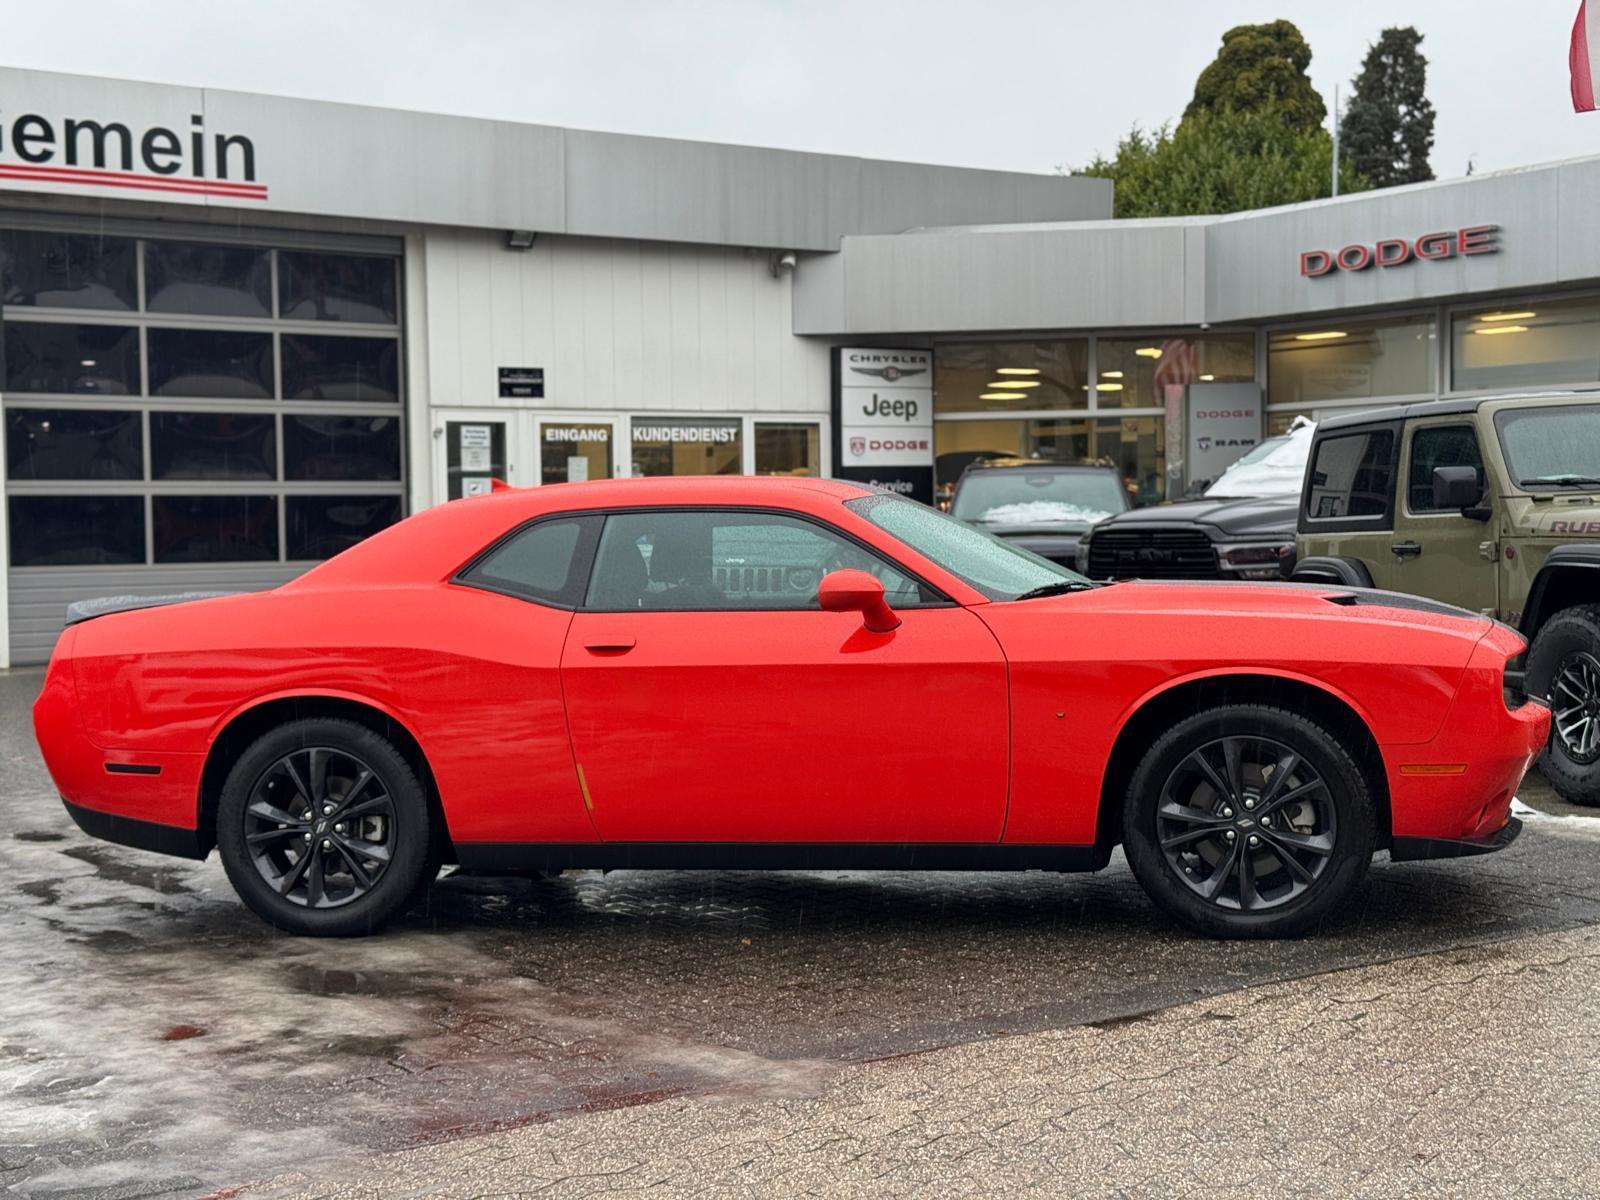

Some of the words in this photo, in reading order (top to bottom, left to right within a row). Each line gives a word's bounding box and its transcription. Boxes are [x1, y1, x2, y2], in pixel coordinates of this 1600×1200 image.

[0, 109, 256, 182] emein
[1300, 225, 1502, 278] DODGE
[849, 354, 927, 364] CHRYSLER
[863, 393, 918, 422] Jeep
[1196, 410, 1254, 418] DODGE
[545, 428, 608, 442] EINGANG
[632, 427, 738, 442] KUNDENDIENST
[869, 440, 929, 451] DODGE
[1215, 439, 1255, 447] RAM
[1550, 520, 1600, 534] RUB
